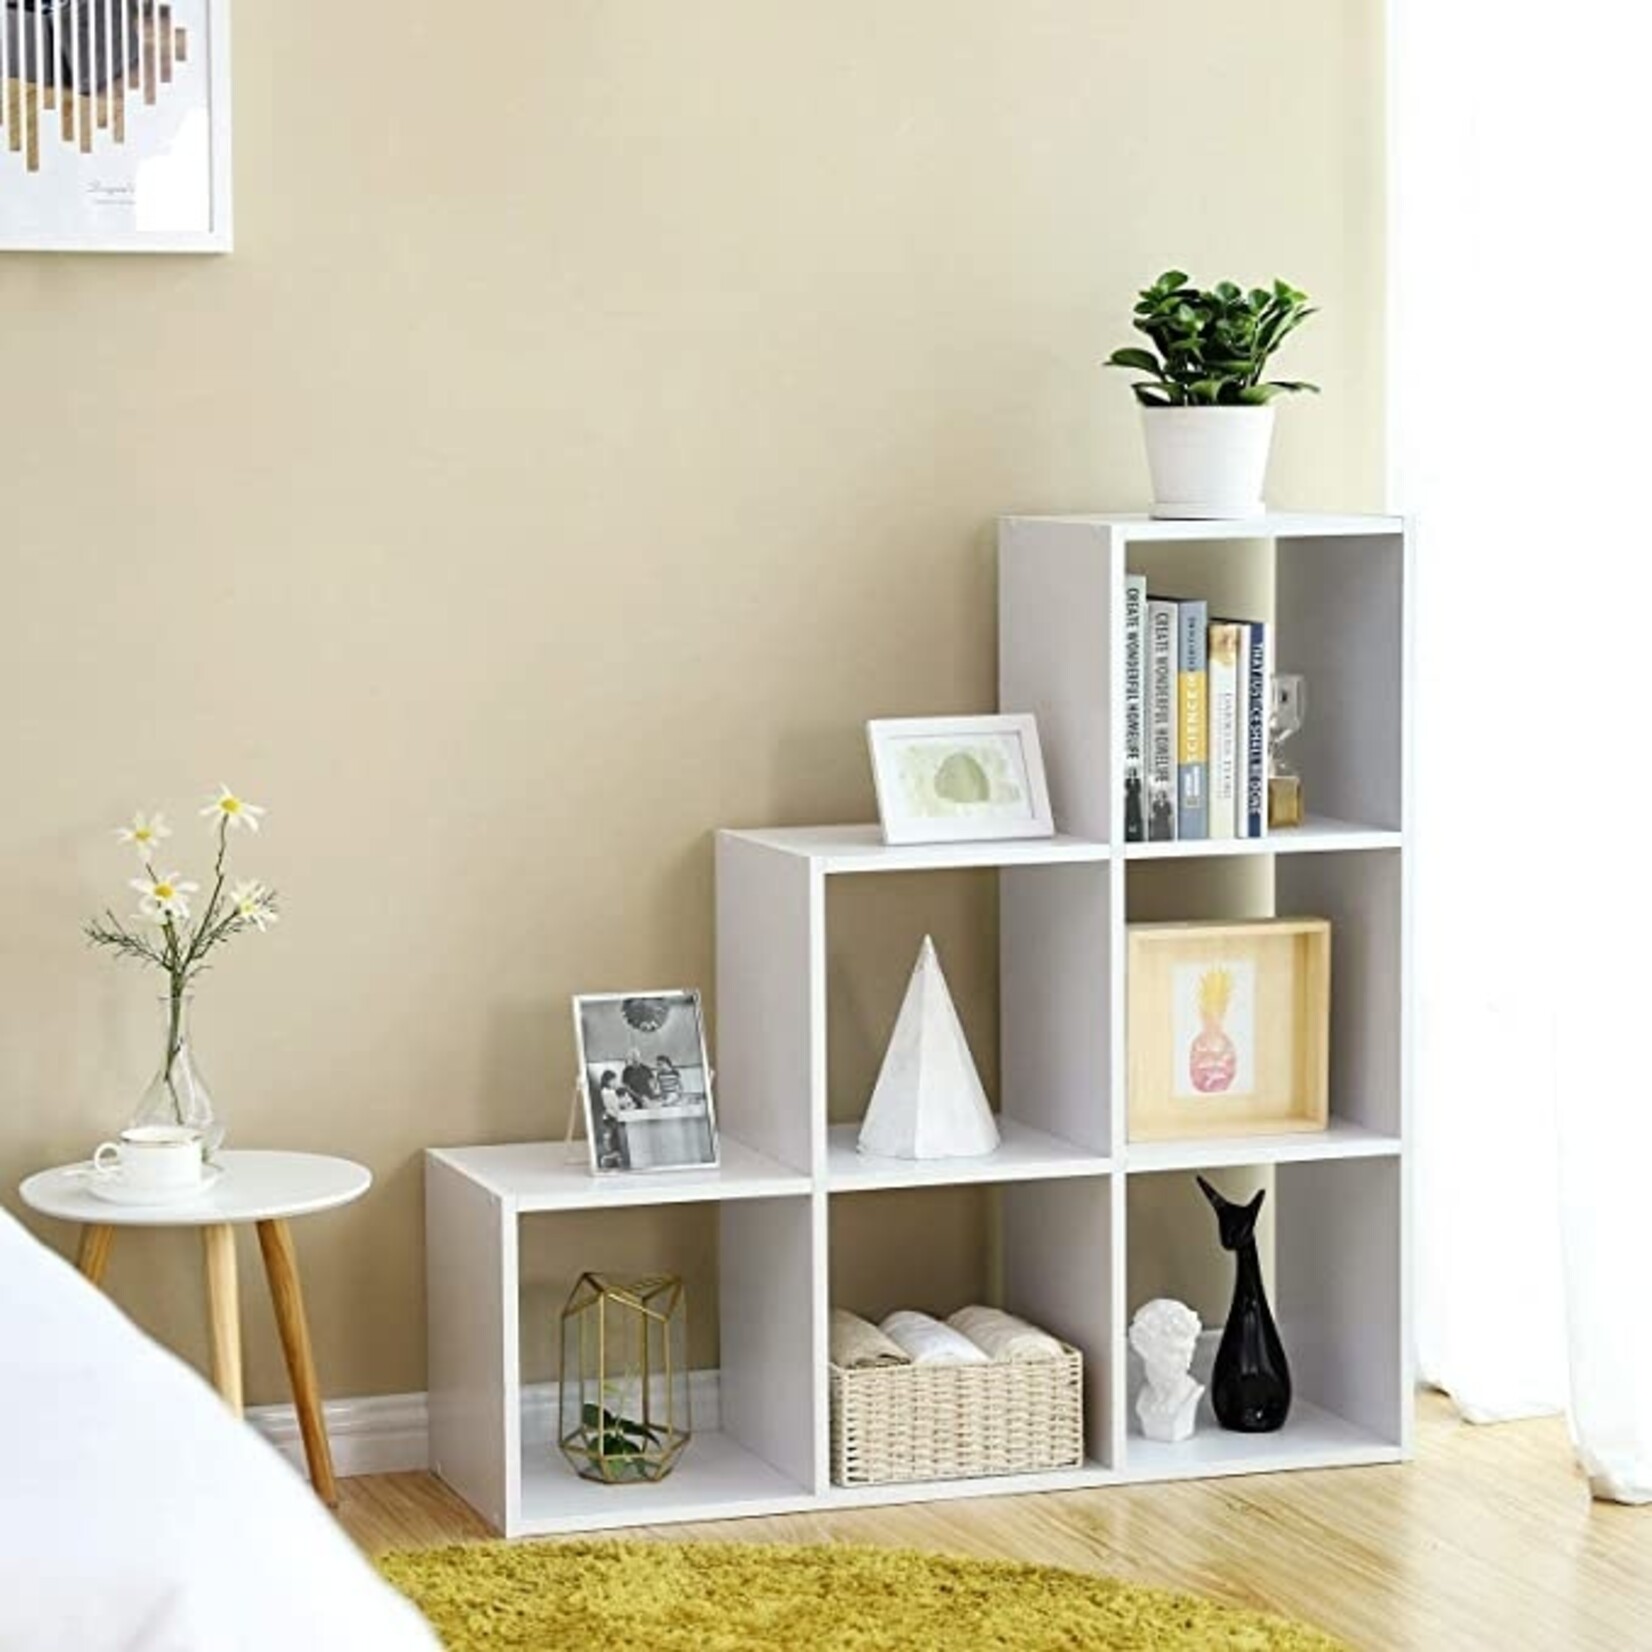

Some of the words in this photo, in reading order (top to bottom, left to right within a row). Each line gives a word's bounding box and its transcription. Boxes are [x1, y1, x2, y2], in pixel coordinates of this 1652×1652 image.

[1126, 588, 1140, 627] CREATE
[1155, 612, 1169, 652] CREATE
[1126, 632, 1140, 700] WONDERFUL
[1250, 643, 1264, 674] THAT
[1155, 656, 1169, 723] WONDERFUL
[1126, 703, 1140, 760] HOMELIFE
[1186, 689, 1198, 762] SCIENCE
